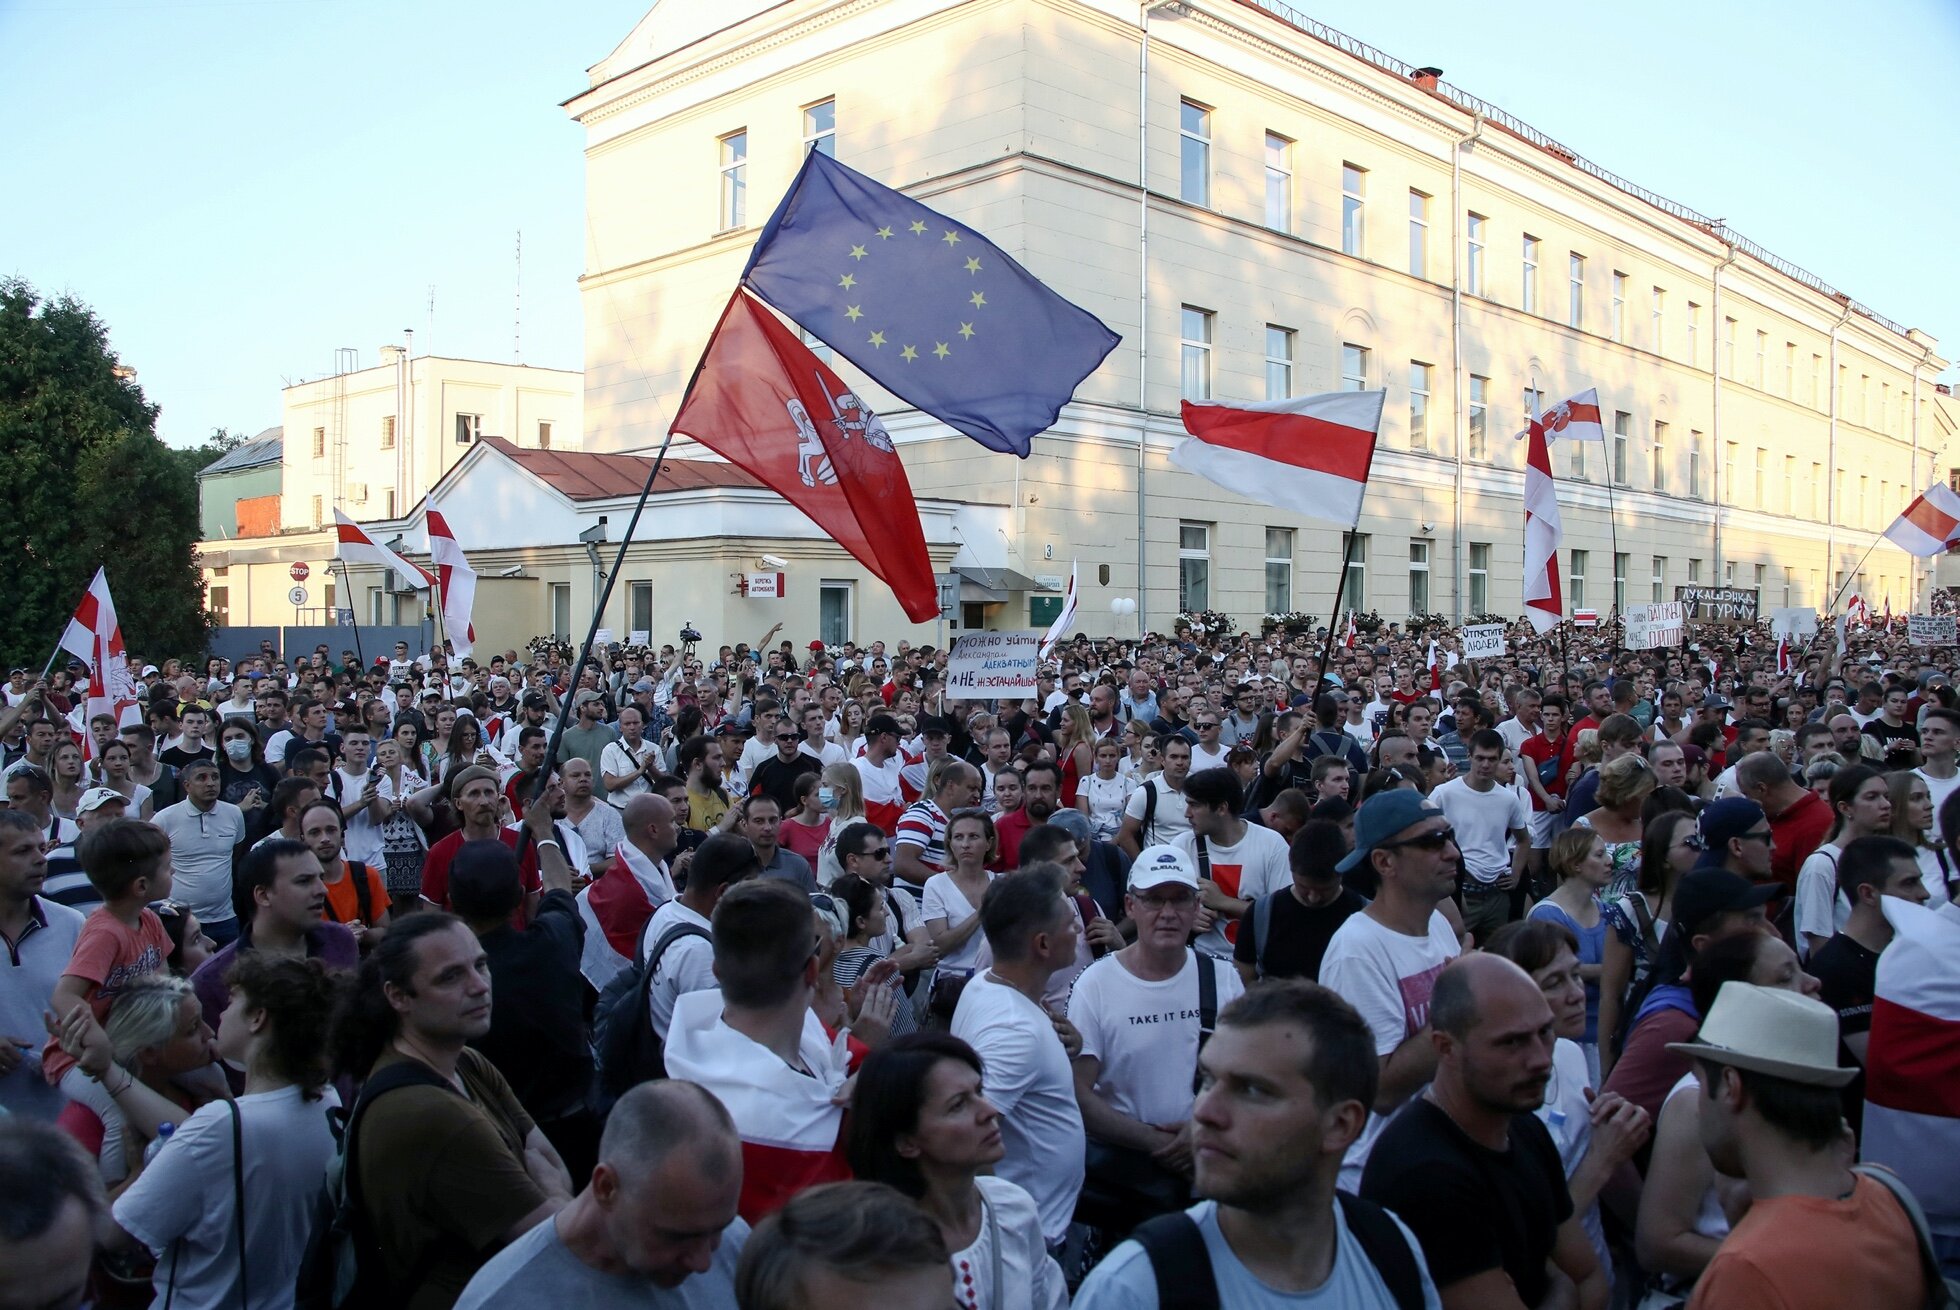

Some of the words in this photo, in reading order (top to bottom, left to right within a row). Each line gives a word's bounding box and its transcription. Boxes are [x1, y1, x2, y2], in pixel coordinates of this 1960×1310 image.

[1046, 544, 1052, 557] 3
[294, 591, 302, 602] 5
[1682, 588, 1756, 605] ЛУКАШЭНКА
[1700, 603, 1755, 620] ТУРМУ
[1463, 627, 1503, 638] ОТПУСТИТЕ
[959, 637, 1001, 649] МОЖНО
[1468, 638, 1499, 651] ЛЮДЕЙ
[982, 659, 1035, 670] АДЕКВАТНЫМ
[960, 671, 975, 687] НЕ
[1128, 1015, 1159, 1025] TAKE
[1164, 1012, 1175, 1022] IT
[1180, 1008, 1200, 1019] EAS
